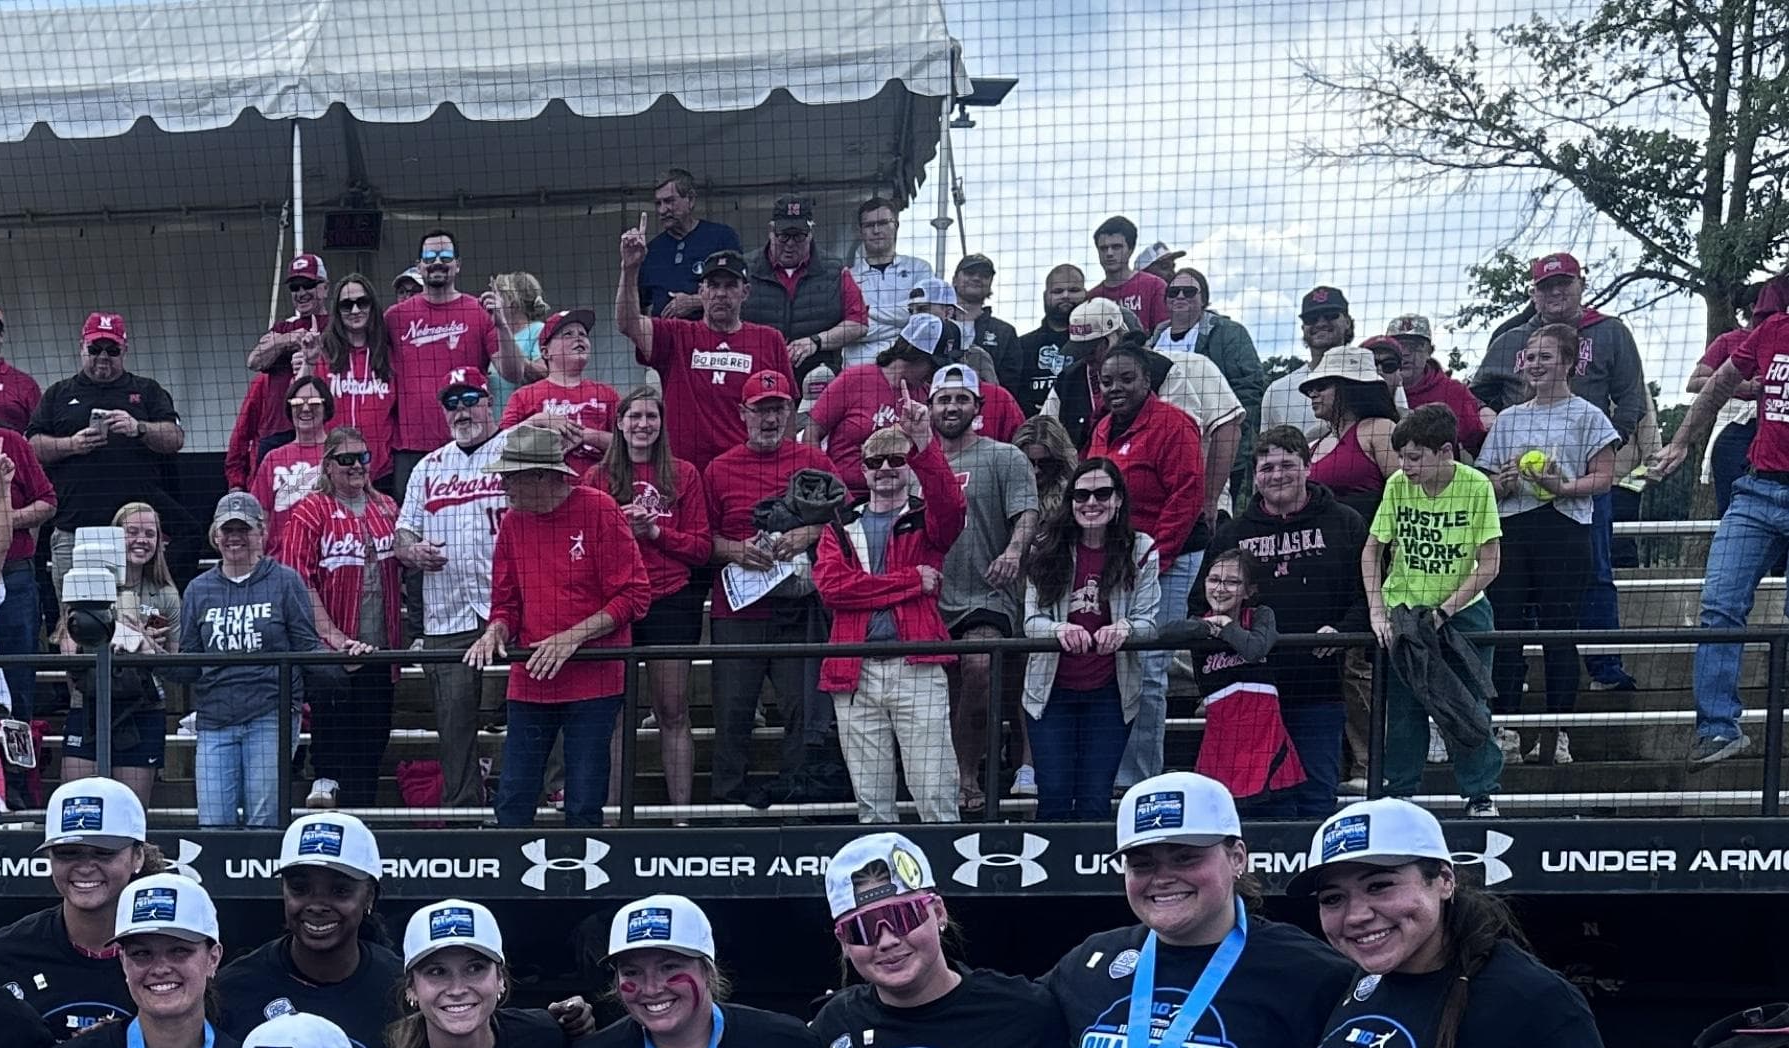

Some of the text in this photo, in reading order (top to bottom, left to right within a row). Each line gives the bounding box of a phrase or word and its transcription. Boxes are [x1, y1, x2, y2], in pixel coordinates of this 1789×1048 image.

[100, 316, 113, 329] N
[401, 319, 468, 341] Nebraska
[693, 355, 708, 365] GO
[730, 358, 750, 369] RED
[327, 373, 390, 400] Nebraska
[450, 370, 466, 384] N
[712, 372, 726, 384] N
[425, 473, 504, 499] Nebrask
[205, 602, 272, 622] ELEVATE
[382, 857, 500, 880] RMOUR
[634, 857, 832, 877] UNDER ARM
[1541, 850, 1789, 872] UNDER ARMO
